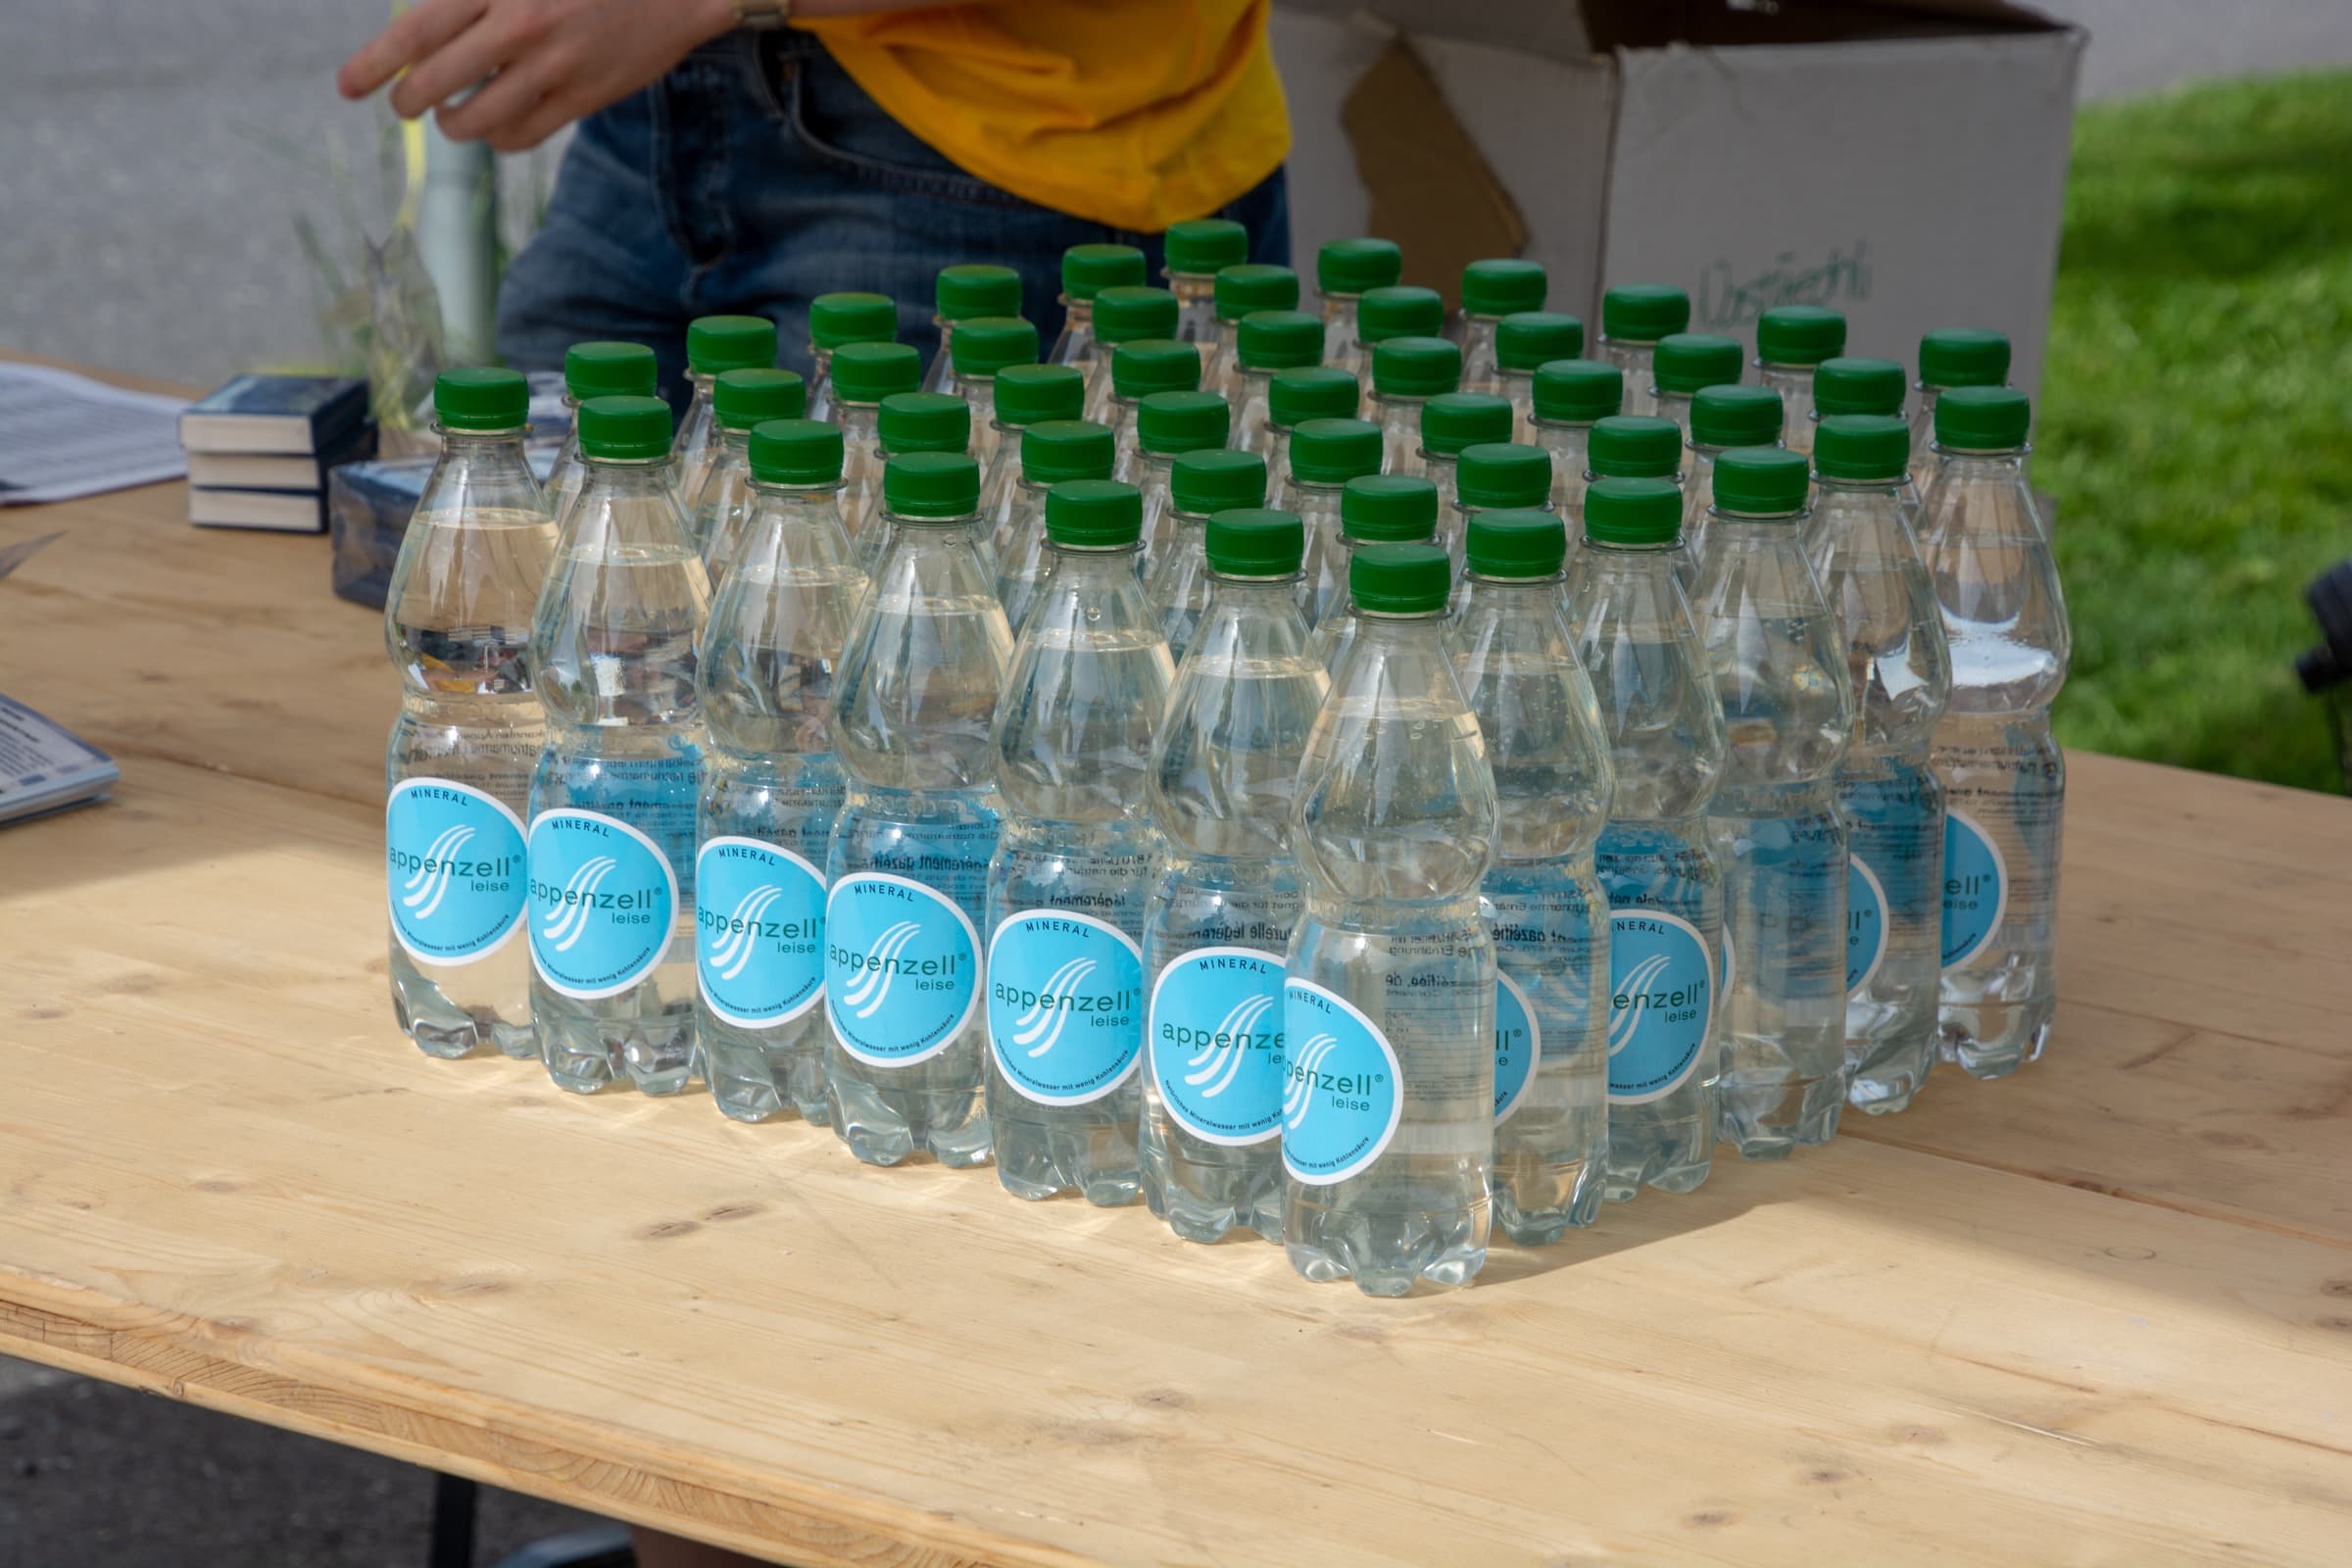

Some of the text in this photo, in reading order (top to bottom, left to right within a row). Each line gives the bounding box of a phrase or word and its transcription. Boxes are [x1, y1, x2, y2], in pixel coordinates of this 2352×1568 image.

[411, 790, 468, 807] MINERAL
[552, 819, 610, 838] MINERAL
[718, 849, 776, 866] MINERAL
[470, 881, 510, 892] leise
[855, 885, 914, 903] MINERAL
[612, 912, 651, 924] leise
[1026, 920, 1090, 938] MINERAL
[1616, 920, 1665, 935] NERAL
[457, 940, 476, 951] wenig
[777, 942, 816, 954] leise
[1200, 958, 1268, 974] MINERAL
[598, 973, 617, 984] wenig
[915, 979, 956, 991] leise
[762, 1002, 783, 1012] wenig
[1091, 1015, 1130, 1027] leise
[1665, 1010, 1697, 1023] leise
[1162, 1022, 1285, 1051] appenze
[900, 1041, 920, 1052] wenig
[1075, 1077, 1096, 1090] wenig
[1648, 1075, 1668, 1087] wenig
[1332, 1096, 1371, 1111] leise
[1189, 1110, 1237, 1131] Mineralwasser
[1251, 1116, 1273, 1128] wenig
[1318, 1159, 1336, 1169] wenig
[1336, 1137, 1369, 1164] Kohlensäure
